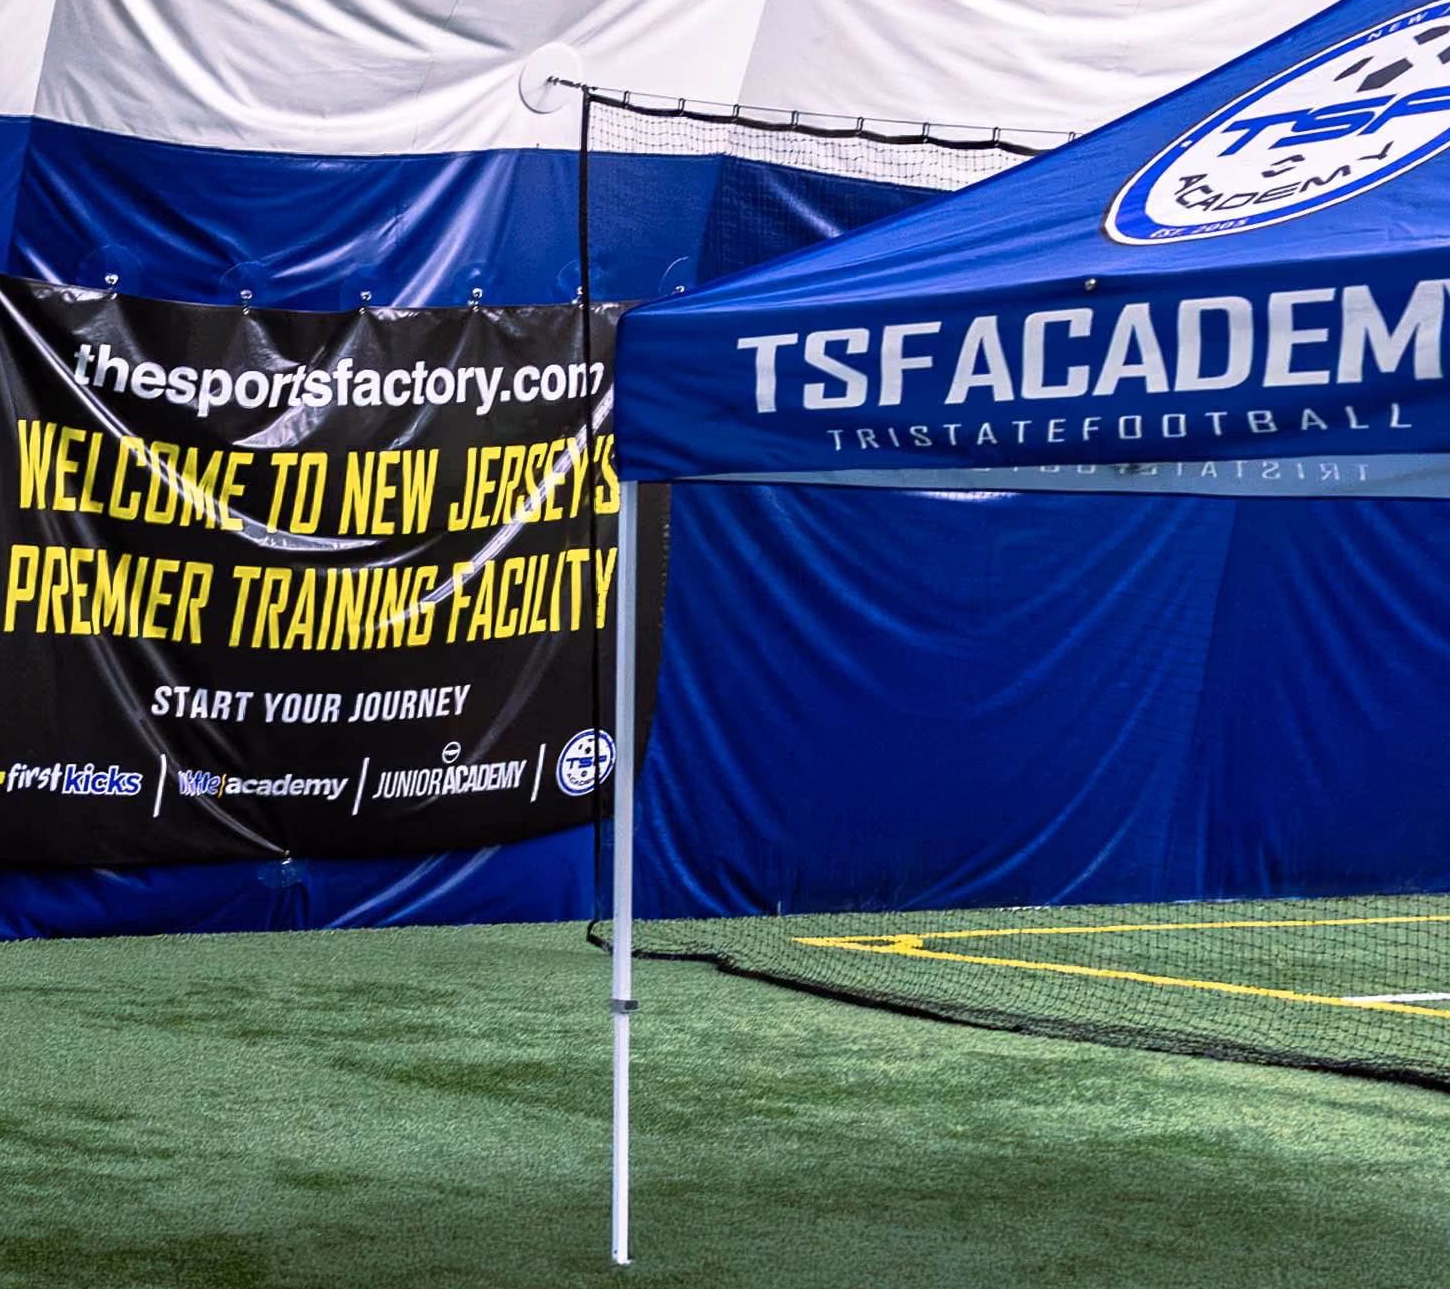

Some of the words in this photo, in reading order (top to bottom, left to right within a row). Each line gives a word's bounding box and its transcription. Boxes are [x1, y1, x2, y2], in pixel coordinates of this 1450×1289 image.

[1366, 11, 1429, 42] NEW
[1174, 140, 1395, 212] ACADEMY
[73, 343, 604, 416] thesportsfactory.com
[17, 419, 255, 532] WELCOME
[266, 452, 329, 536] TO
[338, 448, 440, 536] NEW
[447, 432, 619, 532] JERSEY'S
[3, 544, 214, 644] PREMIER
[228, 564, 437, 651] TRAINING
[446, 547, 618, 644] FACILITY
[151, 686, 254, 722] START
[264, 692, 343, 724] YOUR
[348, 684, 472, 723] JOURNEY
